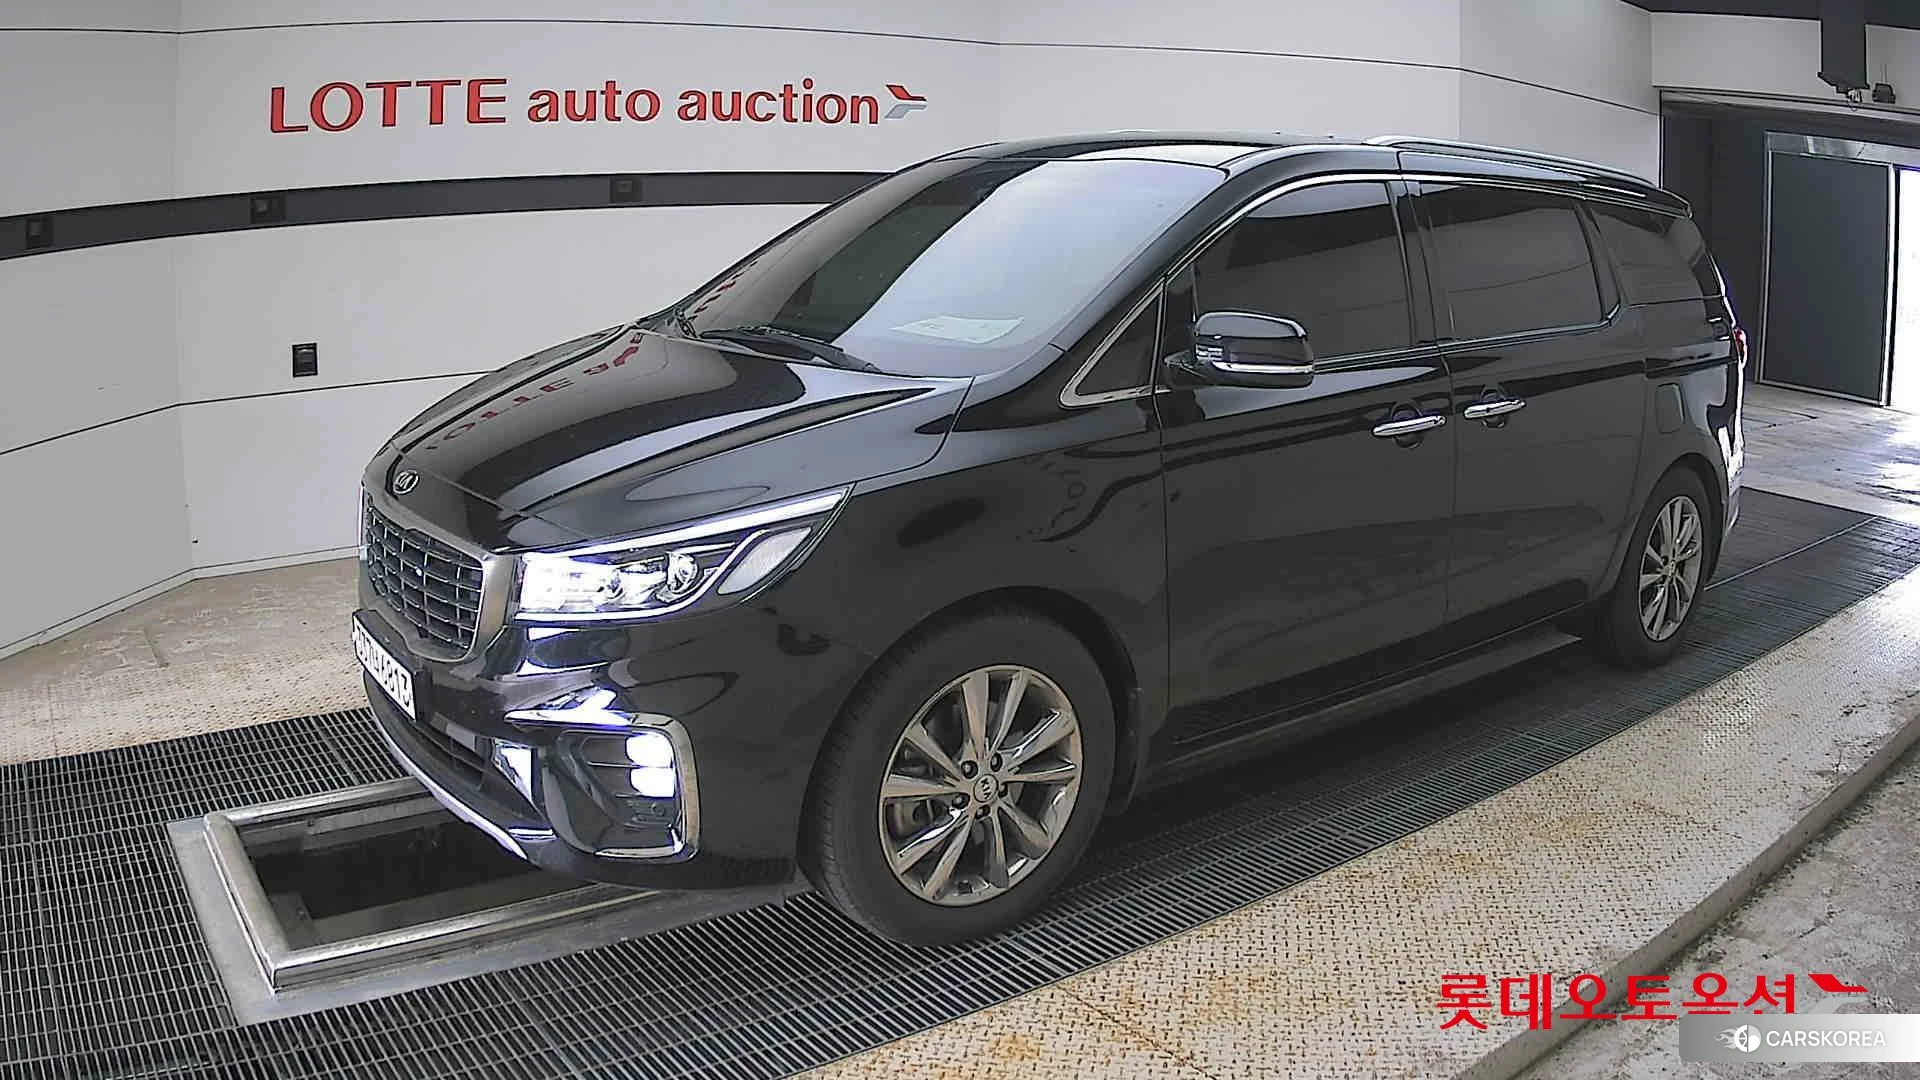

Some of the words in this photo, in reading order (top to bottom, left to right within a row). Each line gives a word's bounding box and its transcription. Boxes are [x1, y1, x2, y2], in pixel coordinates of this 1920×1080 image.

[270, 79, 506, 134] LOTTE
[527, 81, 661, 122] auto
[677, 78, 880, 125] auction
[981, 777, 992, 800] KIA
